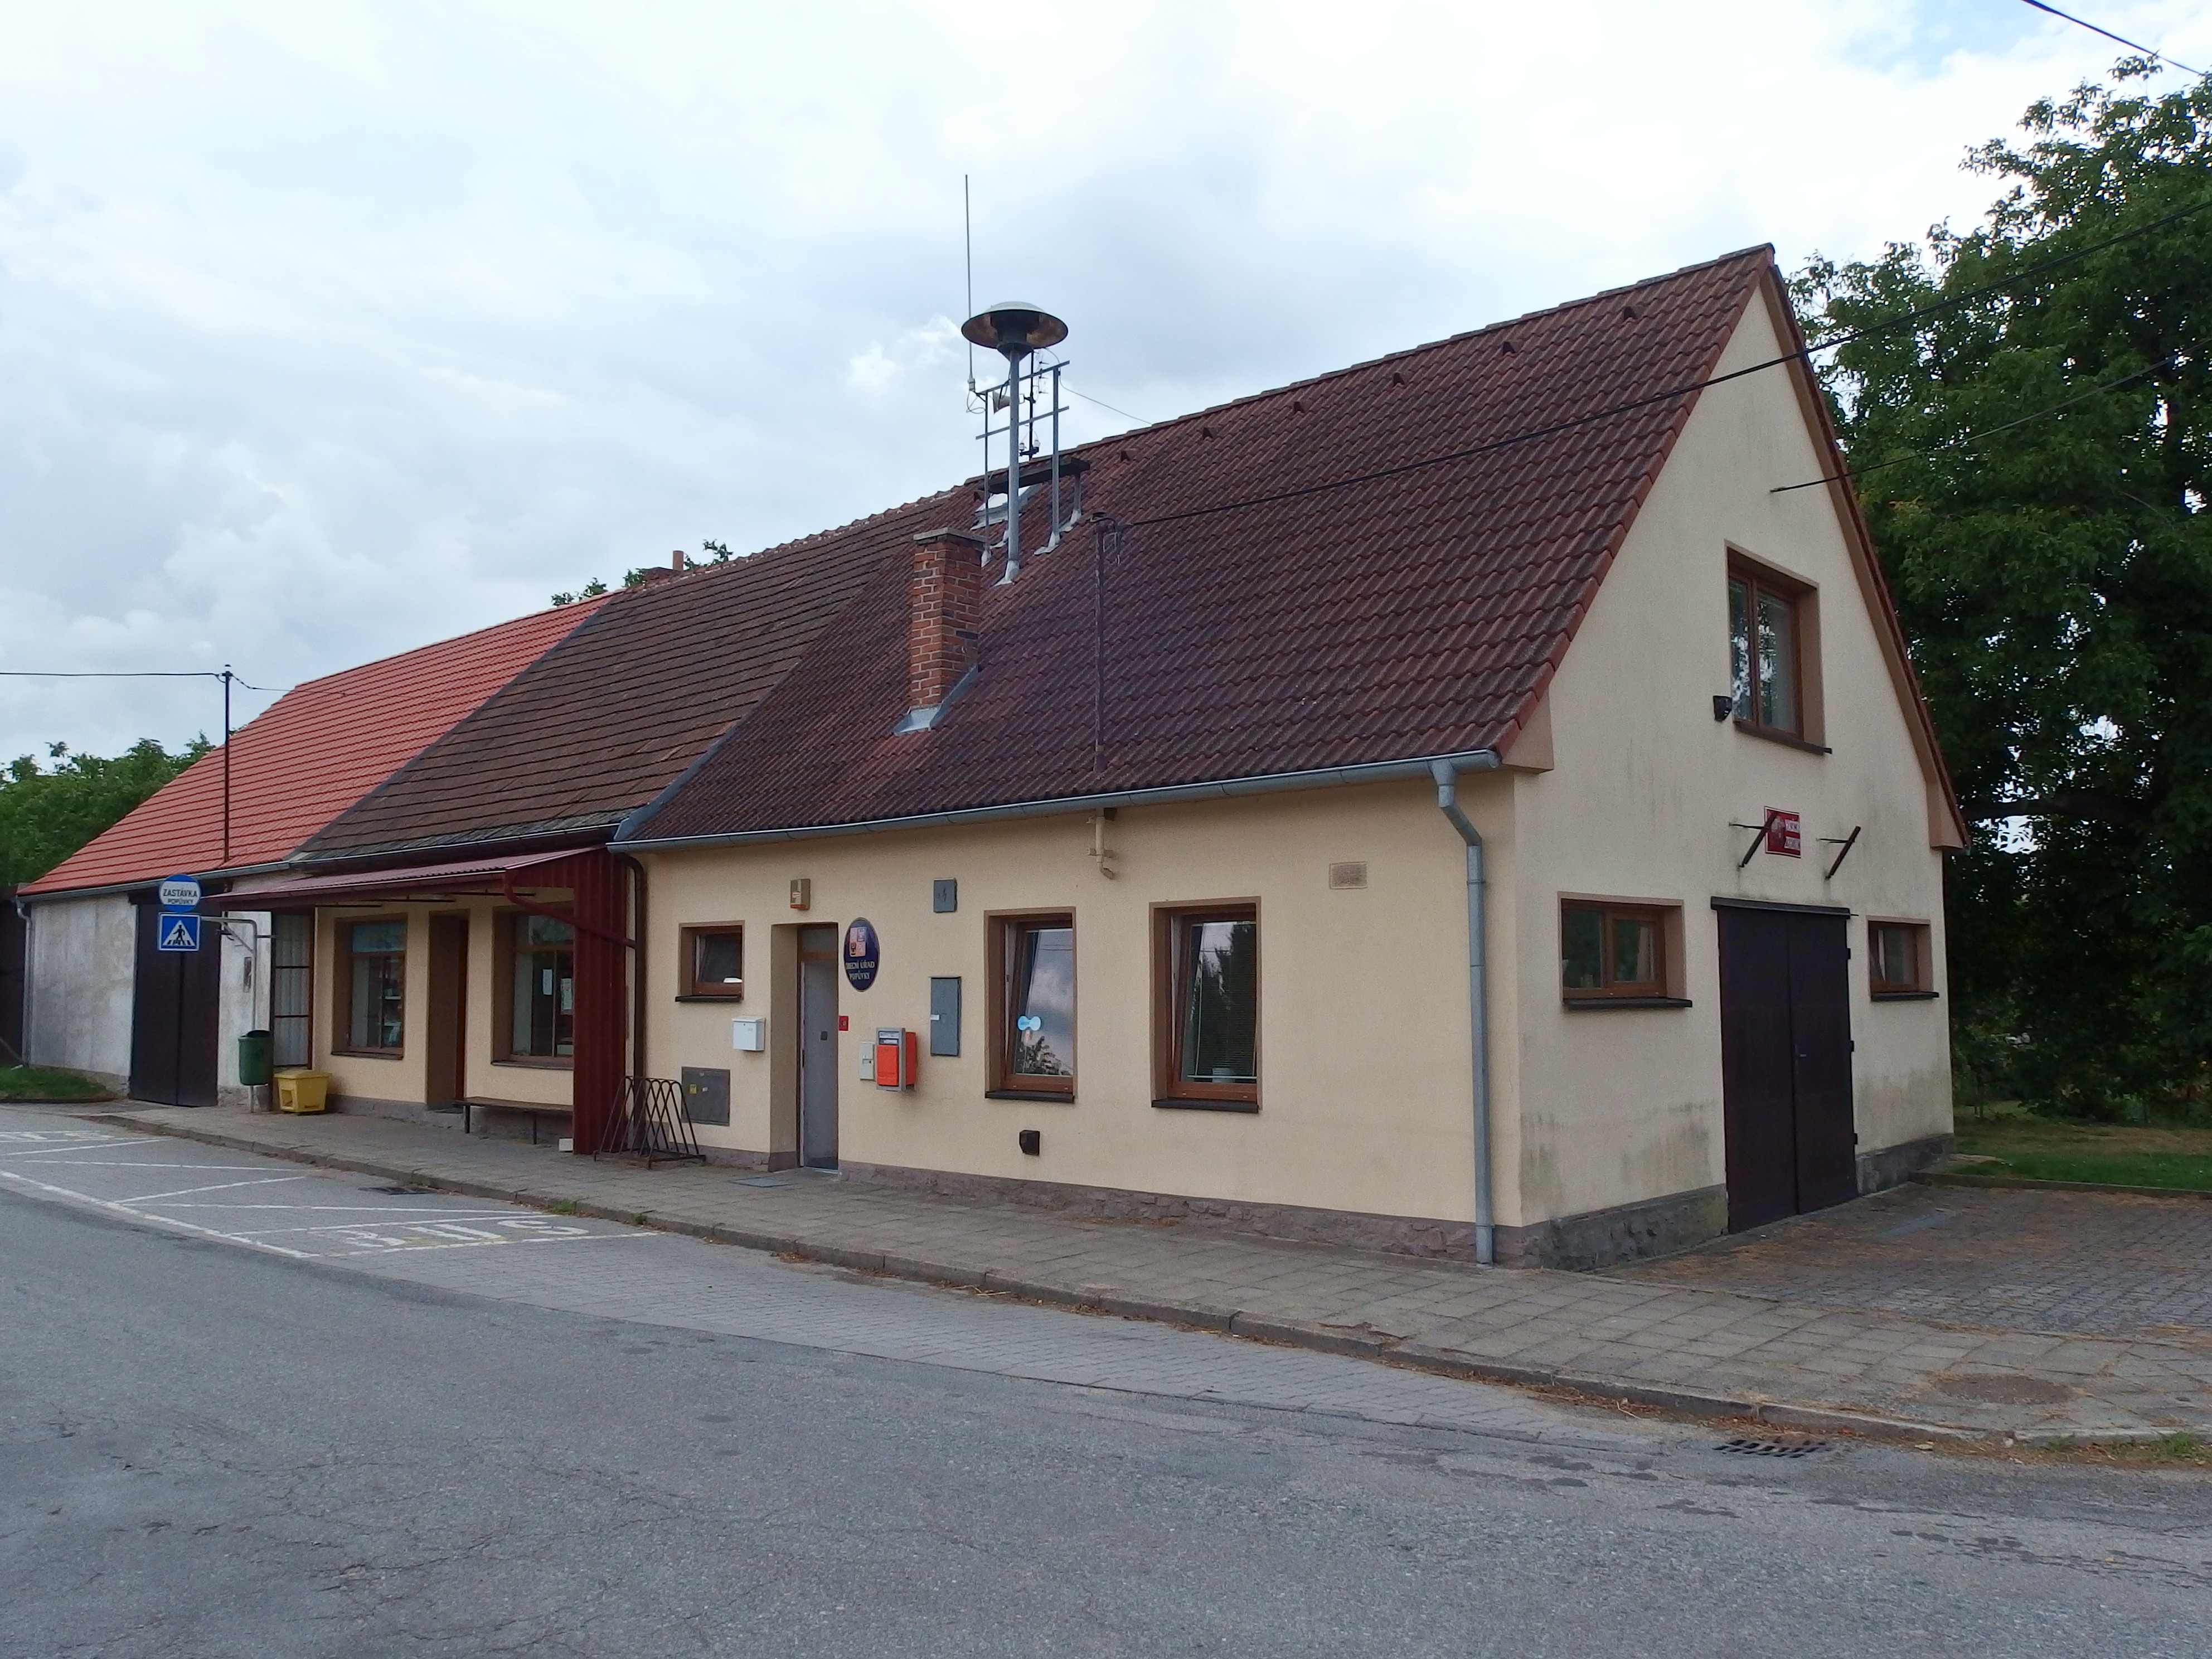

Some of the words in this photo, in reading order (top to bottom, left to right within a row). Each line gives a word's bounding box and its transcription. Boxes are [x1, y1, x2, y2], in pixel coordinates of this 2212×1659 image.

[163, 888, 197, 897] ZASTÁVKA
[845, 961, 859, 969] OBECNÍ
[860, 960, 875, 968] ÚŘAD
[849, 970, 870, 979] POPŮVKY
